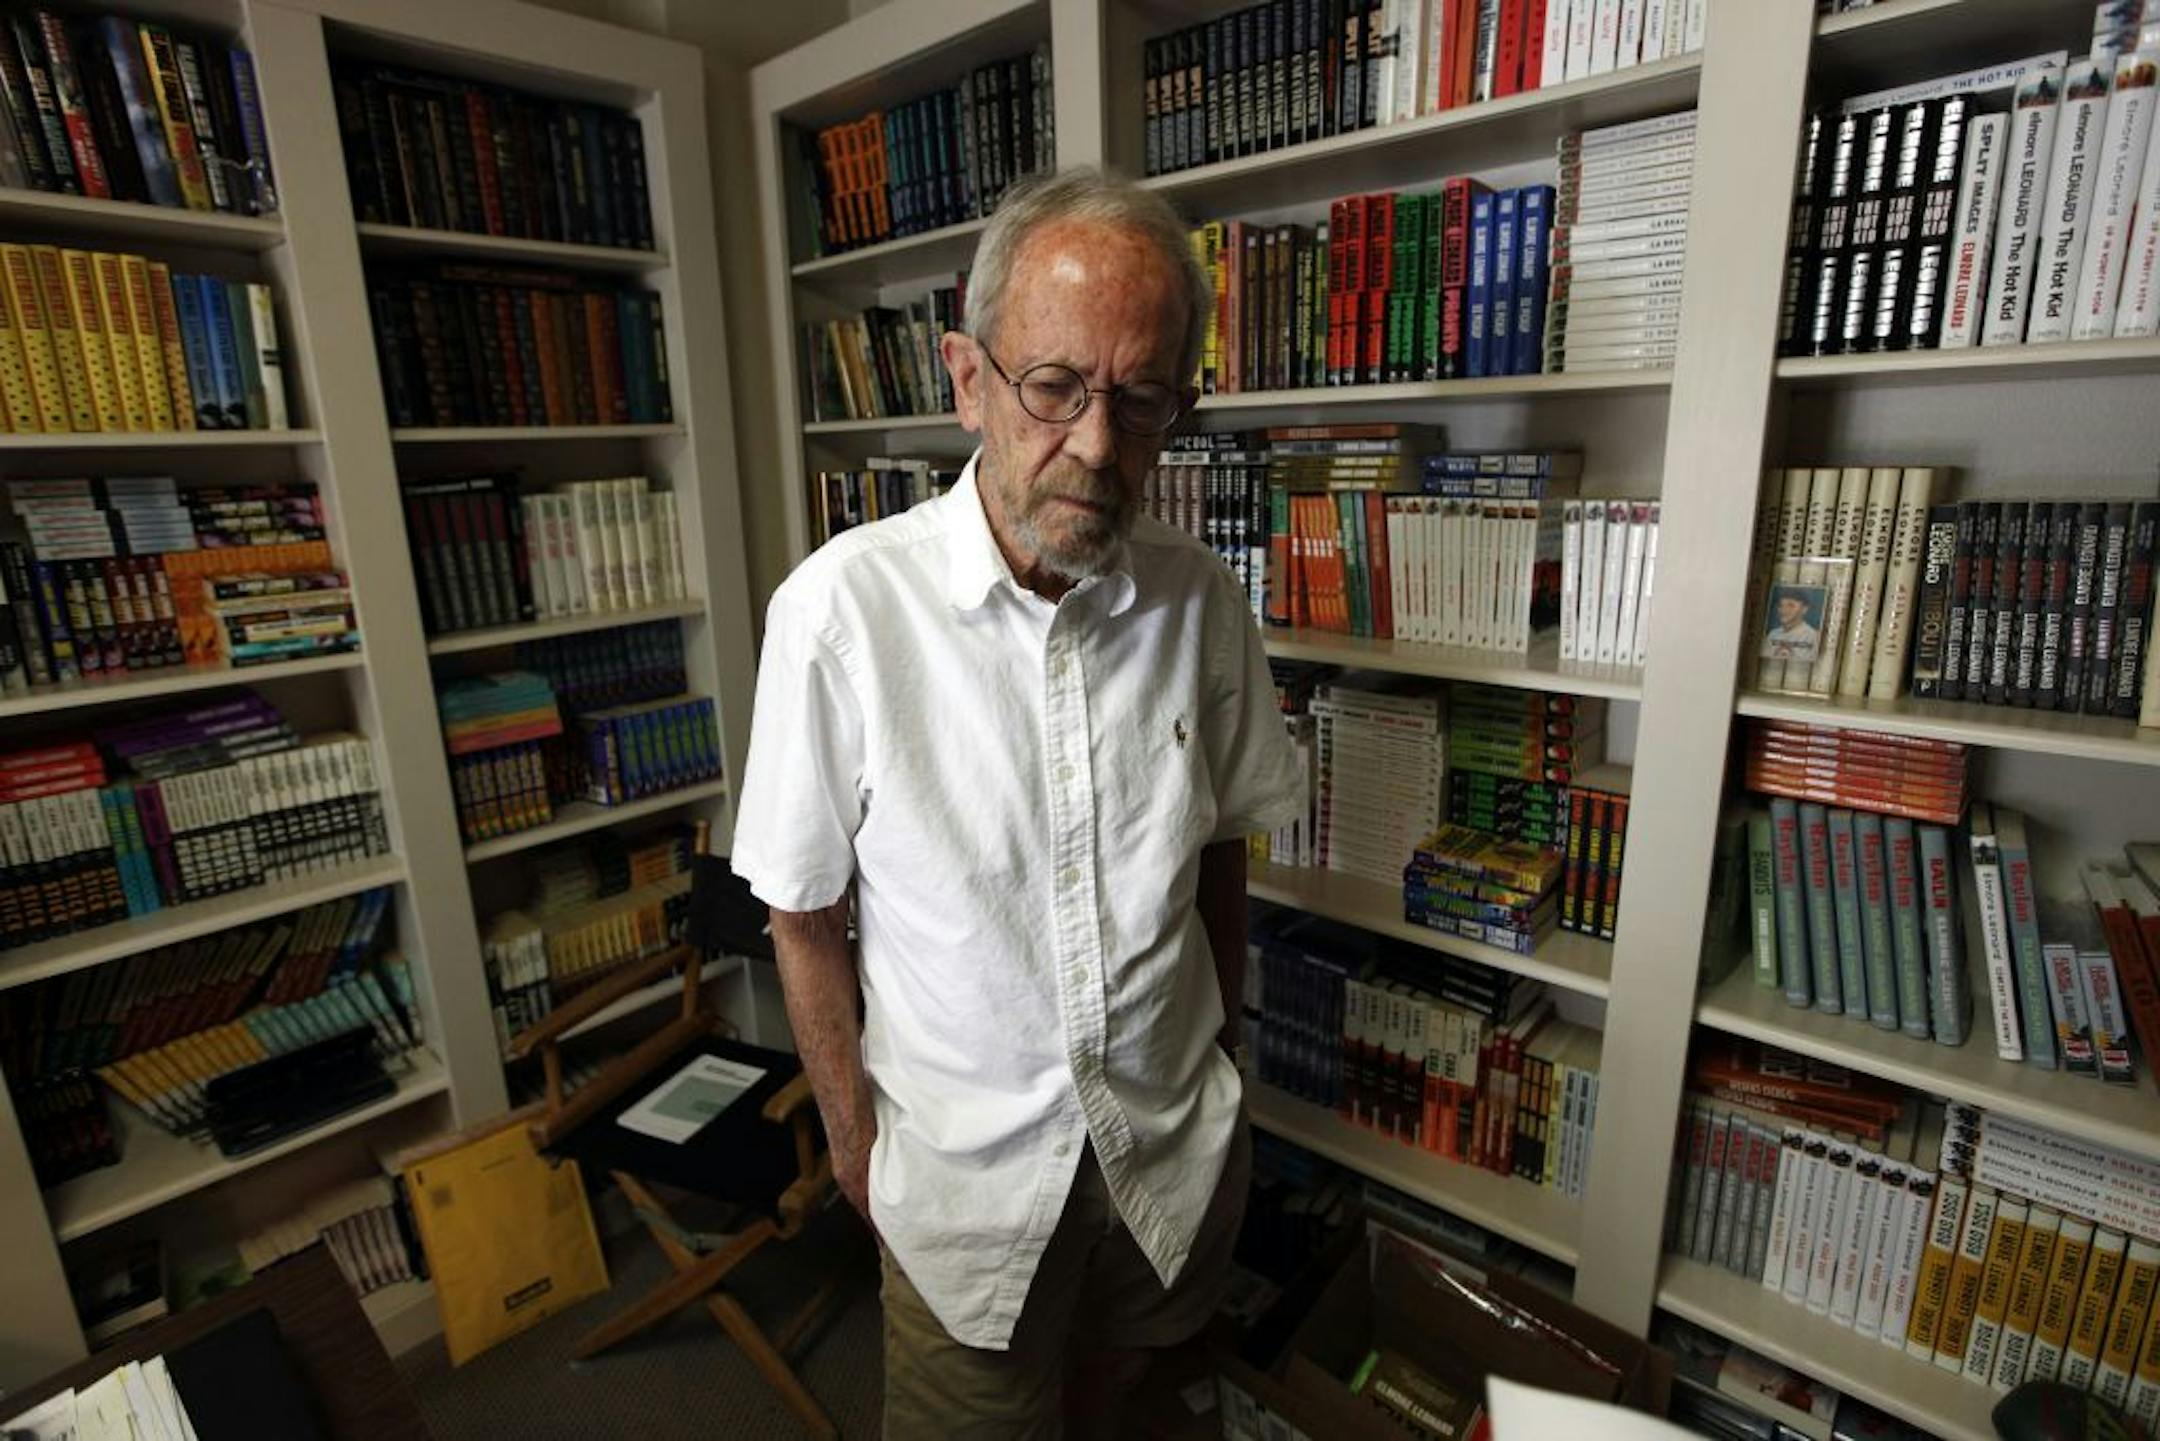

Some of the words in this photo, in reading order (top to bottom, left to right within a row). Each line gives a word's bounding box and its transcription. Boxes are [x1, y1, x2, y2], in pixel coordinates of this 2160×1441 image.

[1973, 121, 1994, 176] SPLIT
[1965, 180, 1984, 234] IMAGES
[2012, 160, 2036, 228] LEONARD
[2060, 153, 2084, 223] LEONARD
[2007, 232, 2025, 262] The
[2054, 227, 2074, 259] The
[2002, 265, 2019, 294] Hot
[2049, 260, 2067, 290] Hot
[1441, 288, 1462, 354] PRONTO
[1998, 295, 2015, 321] Kid
[2045, 292, 2062, 318] Kid
[1859, 502, 1877, 567] LEONARD
[1874, 507, 1891, 563] ELMORE
[1907, 507, 1924, 563] ELMORE
[1923, 521, 1946, 585] LEONARD
[1943, 642, 1962, 681] LEONARD
